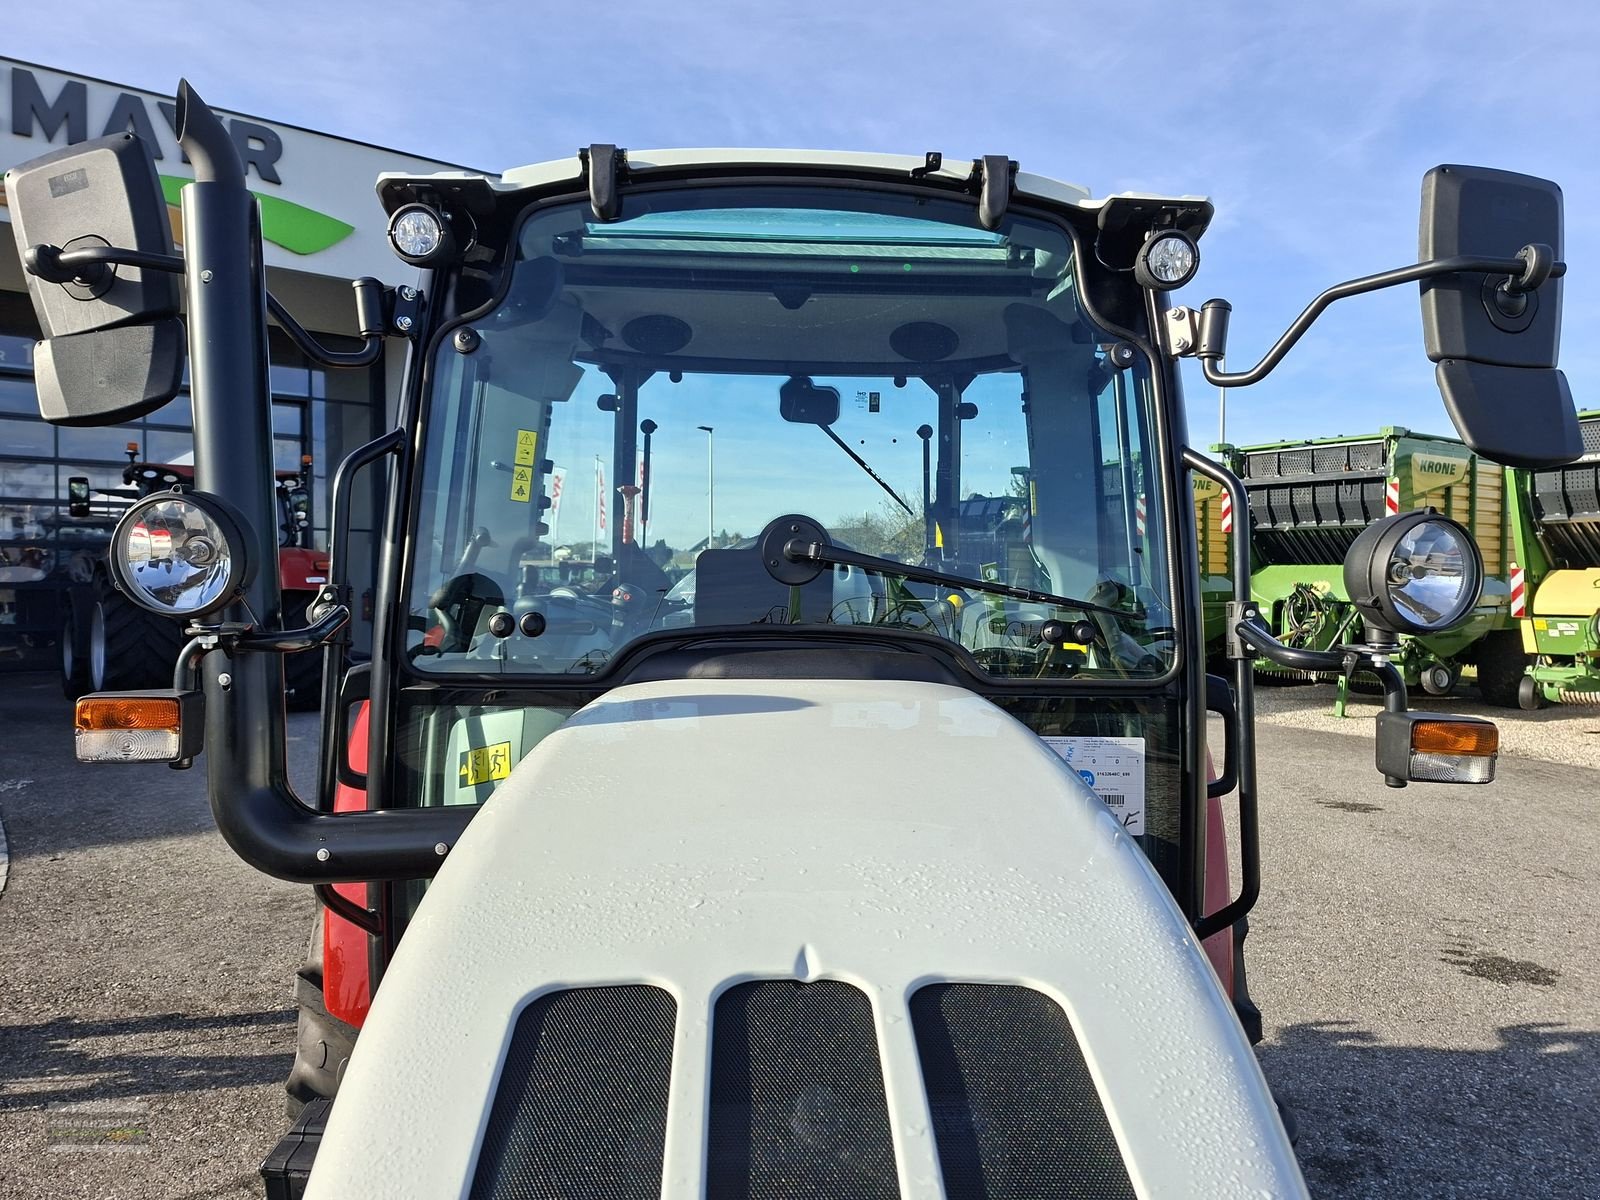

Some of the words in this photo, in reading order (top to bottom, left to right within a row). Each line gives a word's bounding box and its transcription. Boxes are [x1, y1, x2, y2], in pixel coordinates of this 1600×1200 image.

[12, 67, 282, 185] MAR
[1420, 459, 1457, 476] KRONE
[1192, 479, 1212, 491] ONE
